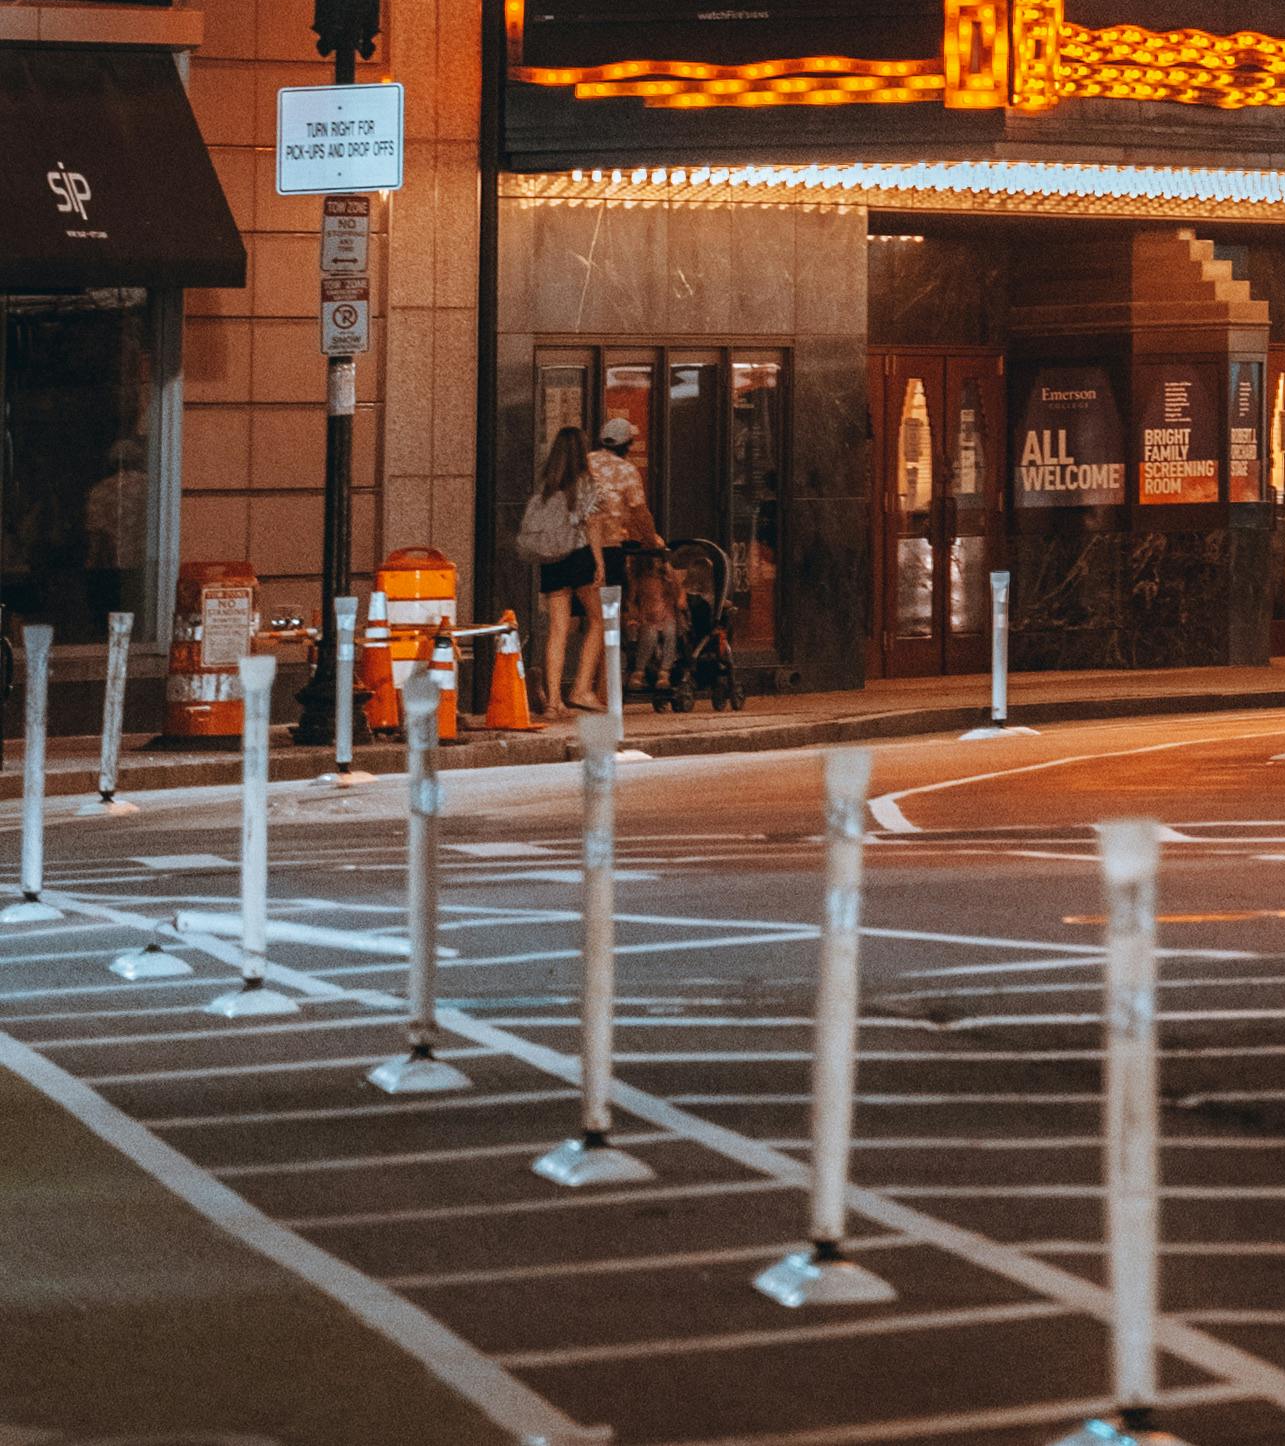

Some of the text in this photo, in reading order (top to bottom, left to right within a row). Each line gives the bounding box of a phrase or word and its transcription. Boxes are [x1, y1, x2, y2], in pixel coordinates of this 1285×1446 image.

[306, 120, 375, 138] TURN RIGHT FOR
[286, 140, 395, 160] PICK-UPS AND DROP OFFS
[347, 201, 368, 214] ZONE
[338, 219, 357, 229] NO
[332, 336, 362, 345] SNOW
[1041, 387, 1097, 401] Emerson
[1145, 428, 1191, 445] BRIGHT
[1021, 430, 1075, 465] ALL
[1144, 445, 1190, 461] FAMILY
[1144, 460, 1215, 477] SCREENING
[1020, 464, 1121, 492] WELCOME
[1145, 477, 1182, 494] ROOM
